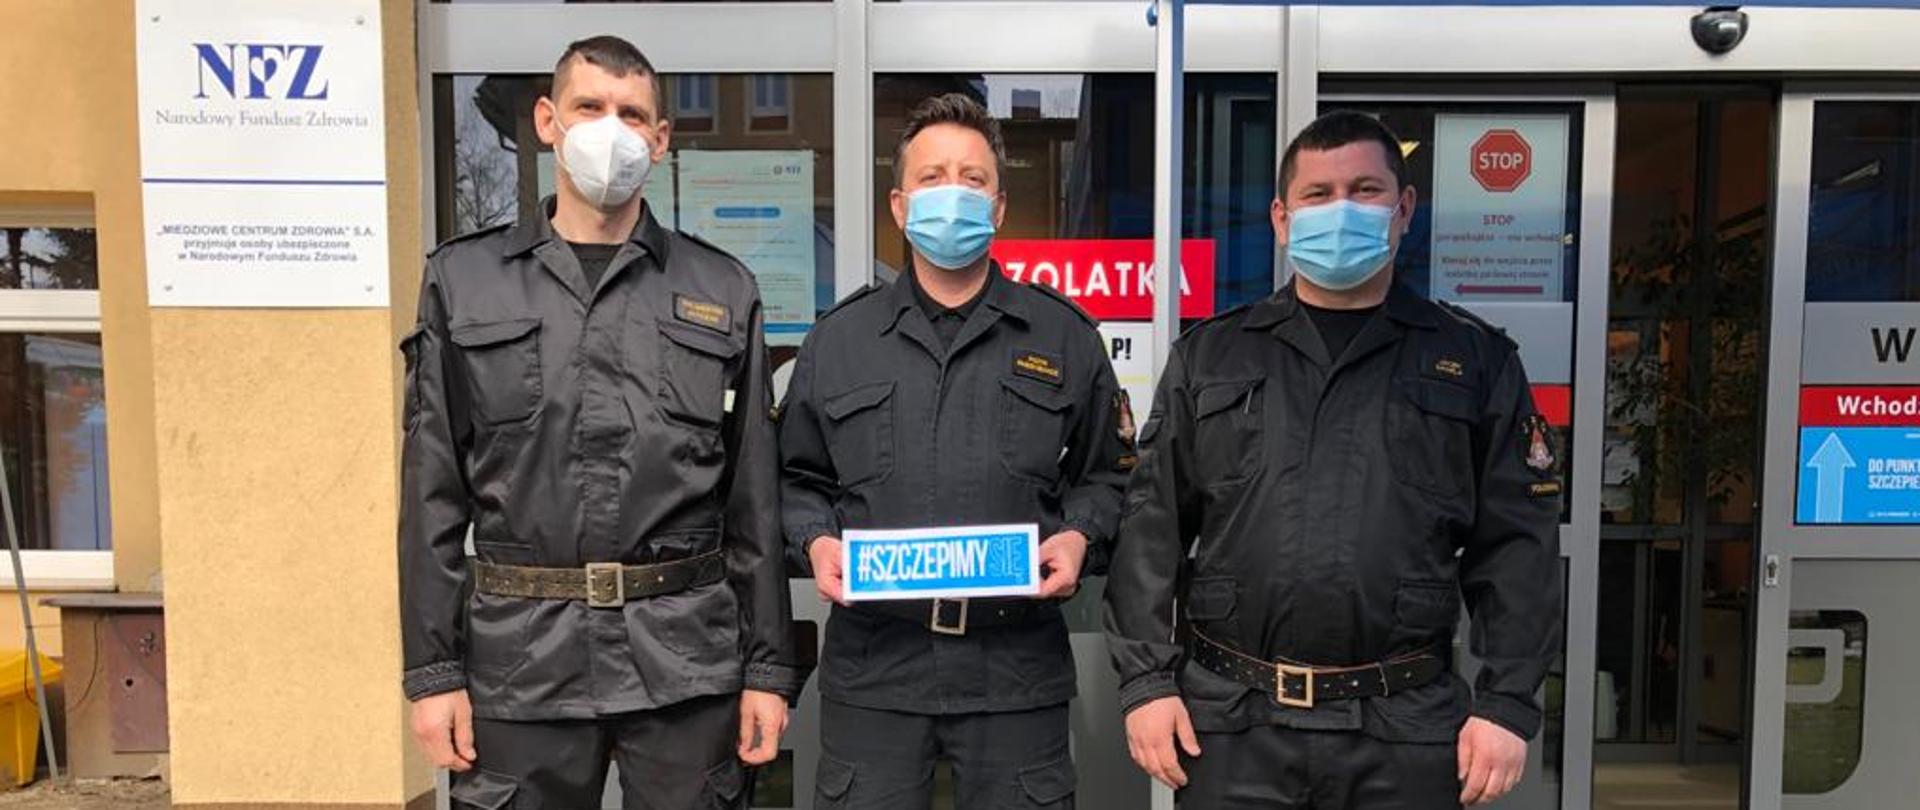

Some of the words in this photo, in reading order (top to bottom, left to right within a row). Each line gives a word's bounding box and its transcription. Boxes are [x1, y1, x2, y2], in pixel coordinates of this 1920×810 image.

[192, 43, 329, 100] NFZ
[156, 110, 234, 127] Narodowy
[240, 111, 302, 126] Fundusz
[307, 111, 368, 126] Zdrowia
[1479, 152, 1524, 170] STOP
[1483, 214, 1514, 226] STOP
[232, 225, 288, 236] CENTRUM
[353, 226, 375, 237] S.A.
[240, 239, 273, 249] osoby
[277, 239, 350, 249] ubezpieczone
[190, 251, 255, 262] Narodowym
[314, 252, 358, 262] Zdrowia
[1005, 261, 1191, 296] ZOLATKA
[1837, 396, 1920, 415] Wchod
[1869, 458, 1883, 473] DO
